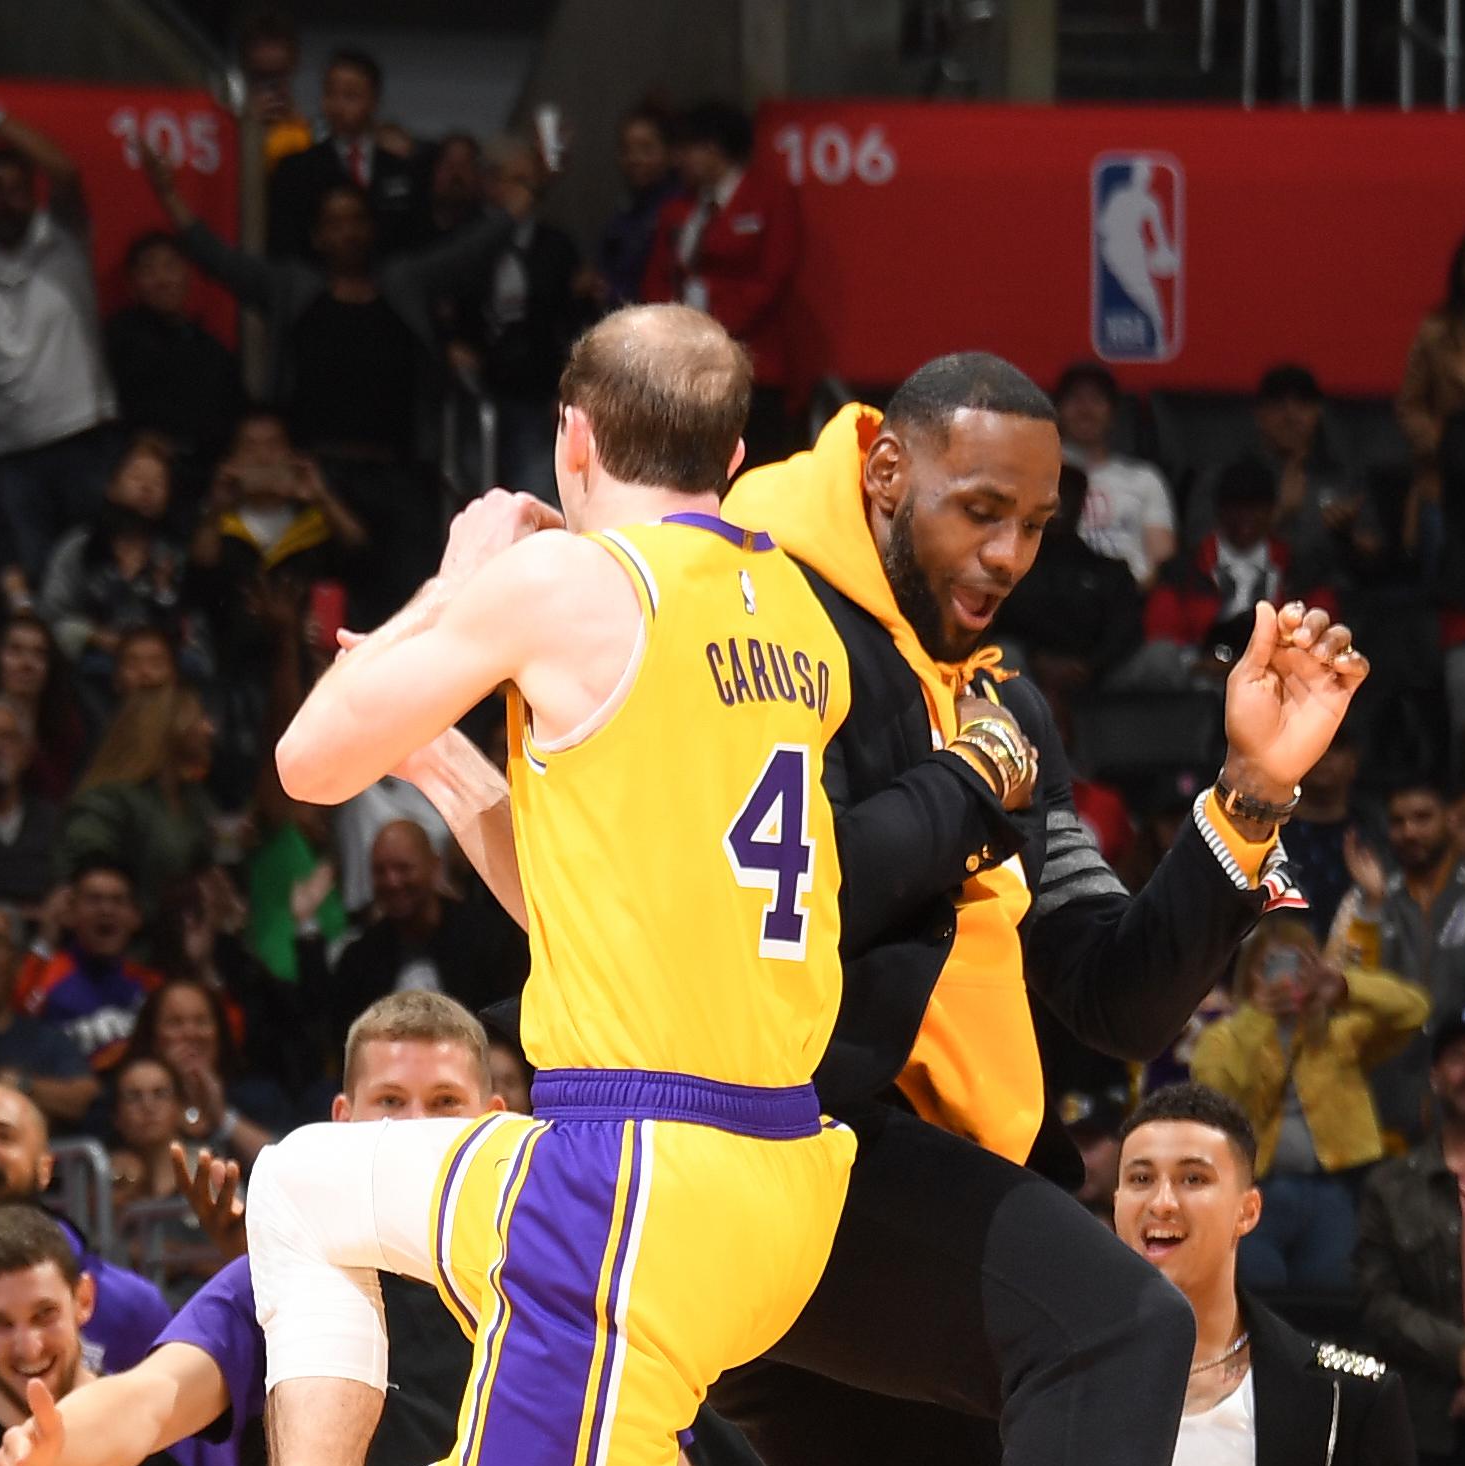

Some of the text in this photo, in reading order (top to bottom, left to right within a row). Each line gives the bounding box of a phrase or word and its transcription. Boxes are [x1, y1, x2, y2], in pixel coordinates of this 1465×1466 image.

[774, 122, 898, 187] 106
[705, 636, 831, 724] CARUSO
[722, 742, 817, 962] 4
